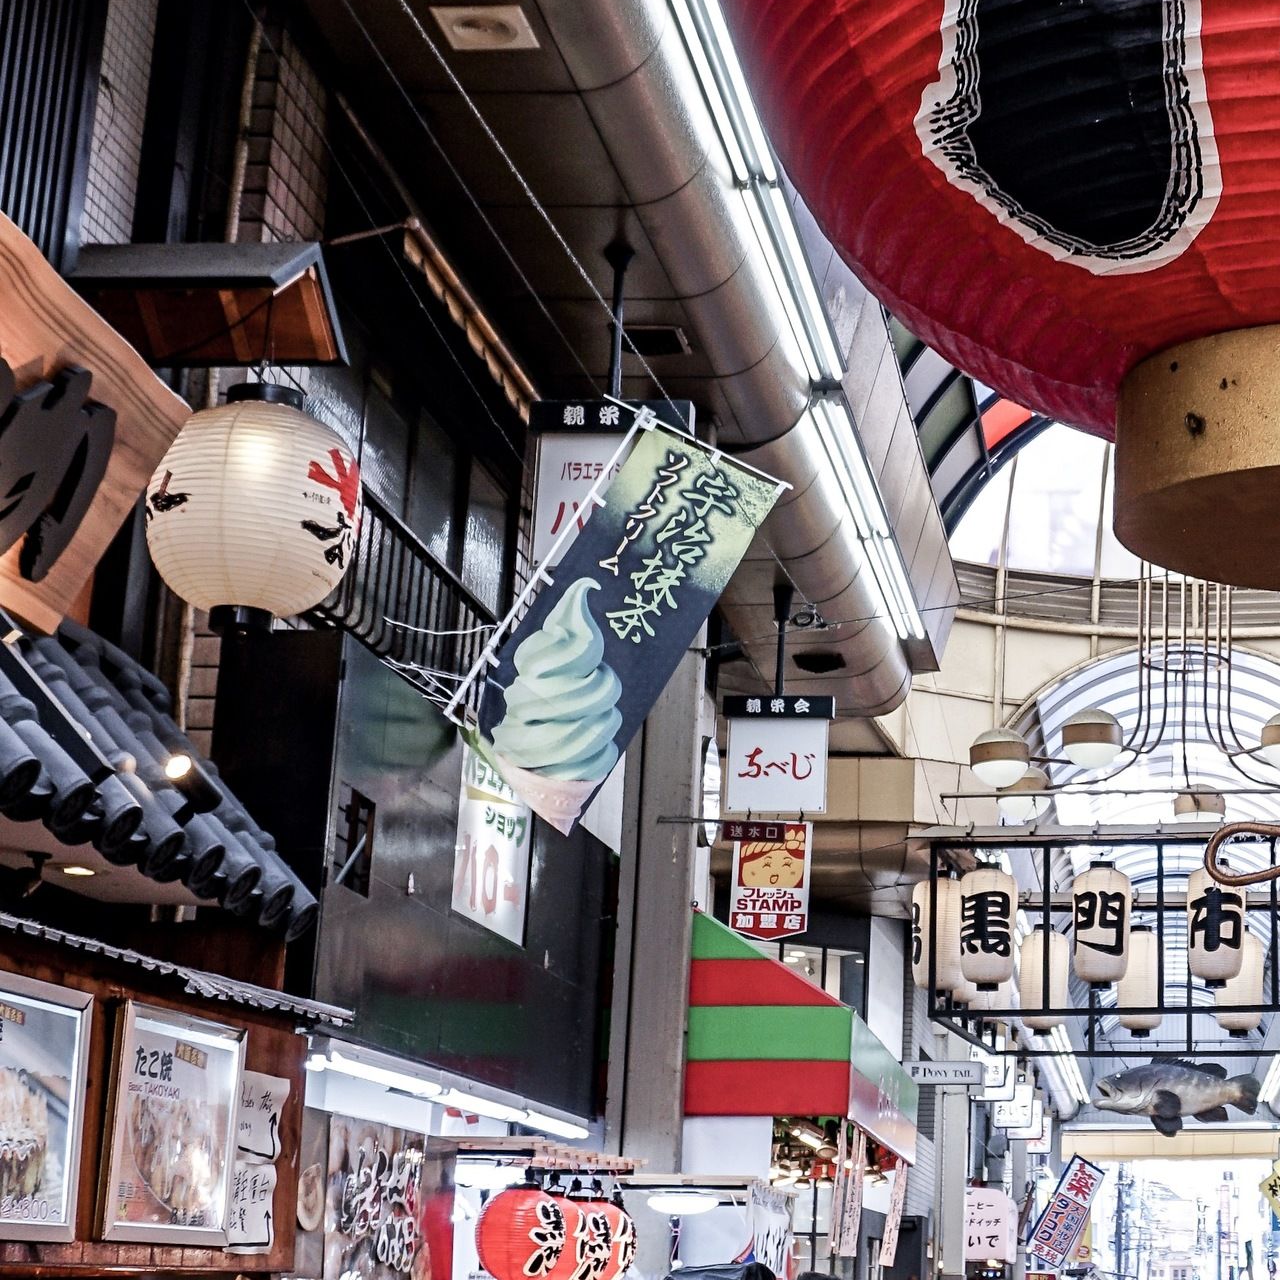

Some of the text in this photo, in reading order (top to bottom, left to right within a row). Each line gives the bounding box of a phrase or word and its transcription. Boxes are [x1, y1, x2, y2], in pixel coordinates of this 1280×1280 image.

[563, 405, 650, 426] 親栄
[598, 450, 689, 577] ソフトクリーム
[605, 471, 739, 644] 宇治抹茶
[745, 698, 811, 713] 親栄会
[730, 825, 778, 839] 送水口
[743, 887, 795, 899] フレッシュ
[736, 898, 802, 912] STAMP
[735, 913, 802, 930] 加盟店
[135, 1045, 173, 1082] たこ焼
[144, 1082, 180, 1099] TAKOYAKI
